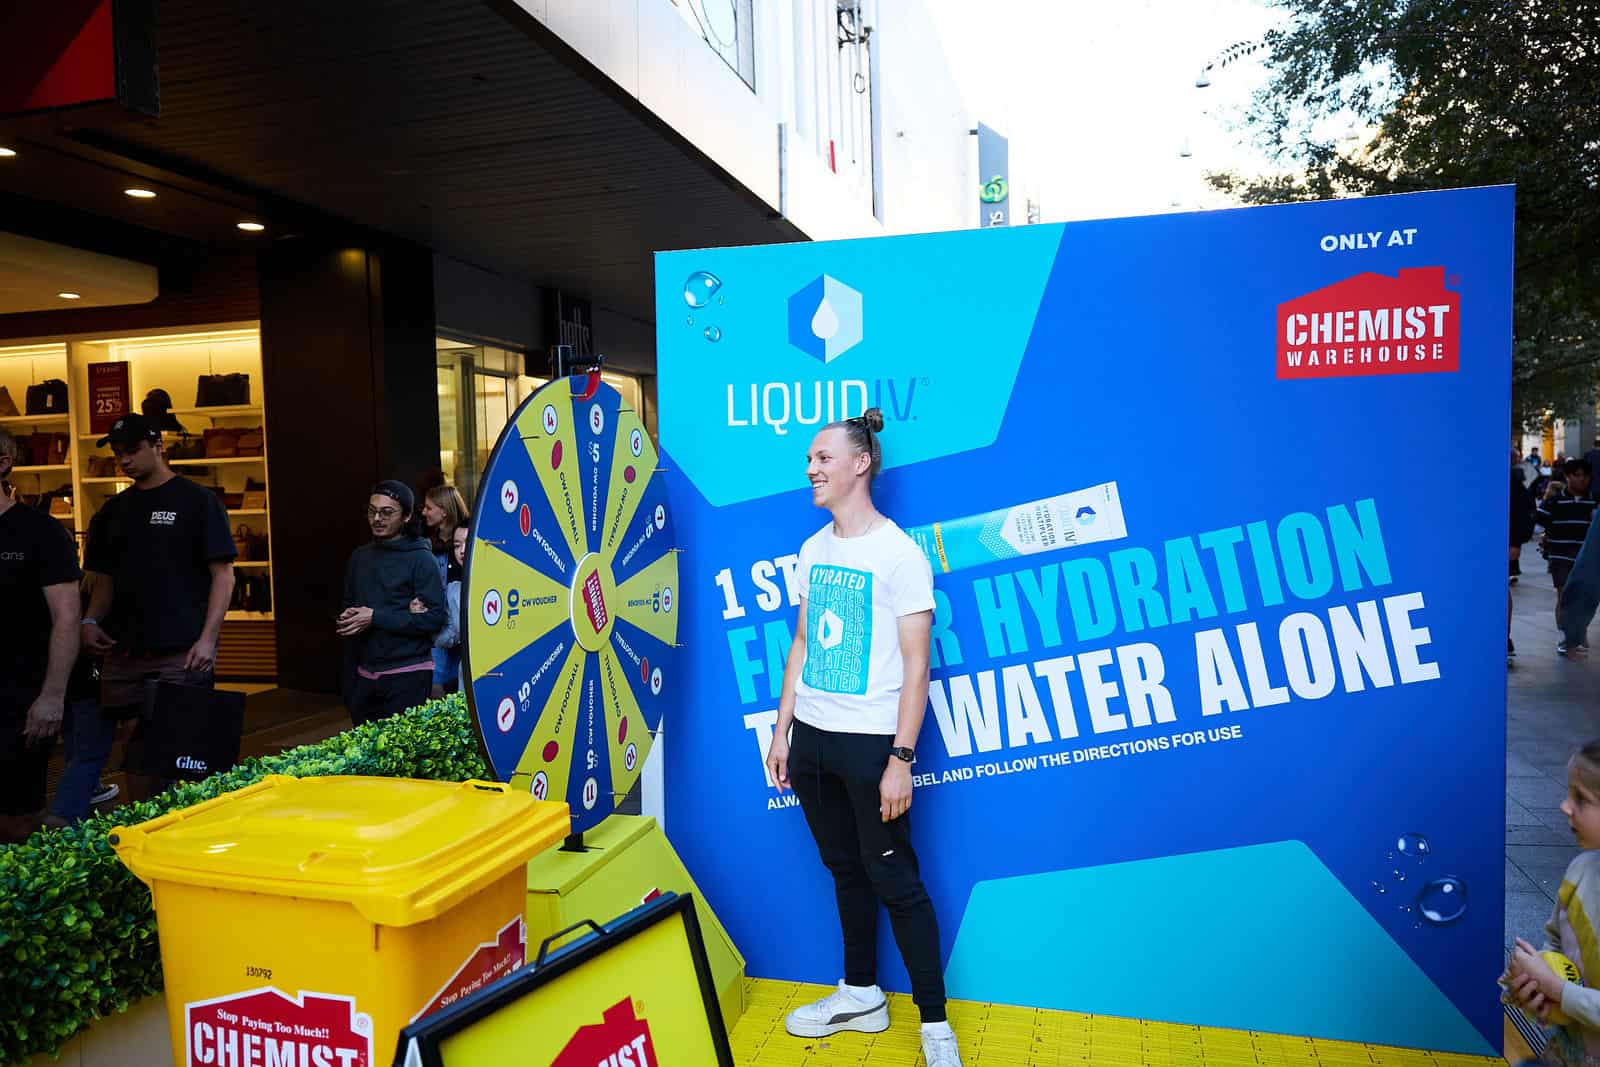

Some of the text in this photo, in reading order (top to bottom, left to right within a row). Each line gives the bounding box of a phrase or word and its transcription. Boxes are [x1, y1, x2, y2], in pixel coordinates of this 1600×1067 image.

[1320, 228, 1417, 252] ONLY AT
[1286, 305, 1450, 346] CHEMIST
[1286, 343, 1444, 367] WAREHOUSE
[546, 413, 555, 427] 4
[593, 412, 600, 427] 5
[727, 379, 869, 435] LIQUID
[505, 488, 515, 504] 3
[152, 511, 176, 521] DEUS
[565, 491, 580, 545] FOOTBALL
[541, 541, 567, 573] FOOTBALL
[715, 553, 801, 620] 1 ST
[973, 498, 1393, 658] HYDRATION
[487, 599, 498, 614] 2
[560, 663, 579, 714] FOOTBALL
[928, 641, 1177, 758] WATER
[1194, 591, 1441, 716] ALONE
[501, 707, 511, 724] 1
[912, 725, 1243, 789] BEL AND FOLLOW THE DIRECTIONS FOR USE
[586, 786, 595, 796] 11
[217, 1009, 330, 1039] Stop Paying Too Much!!
